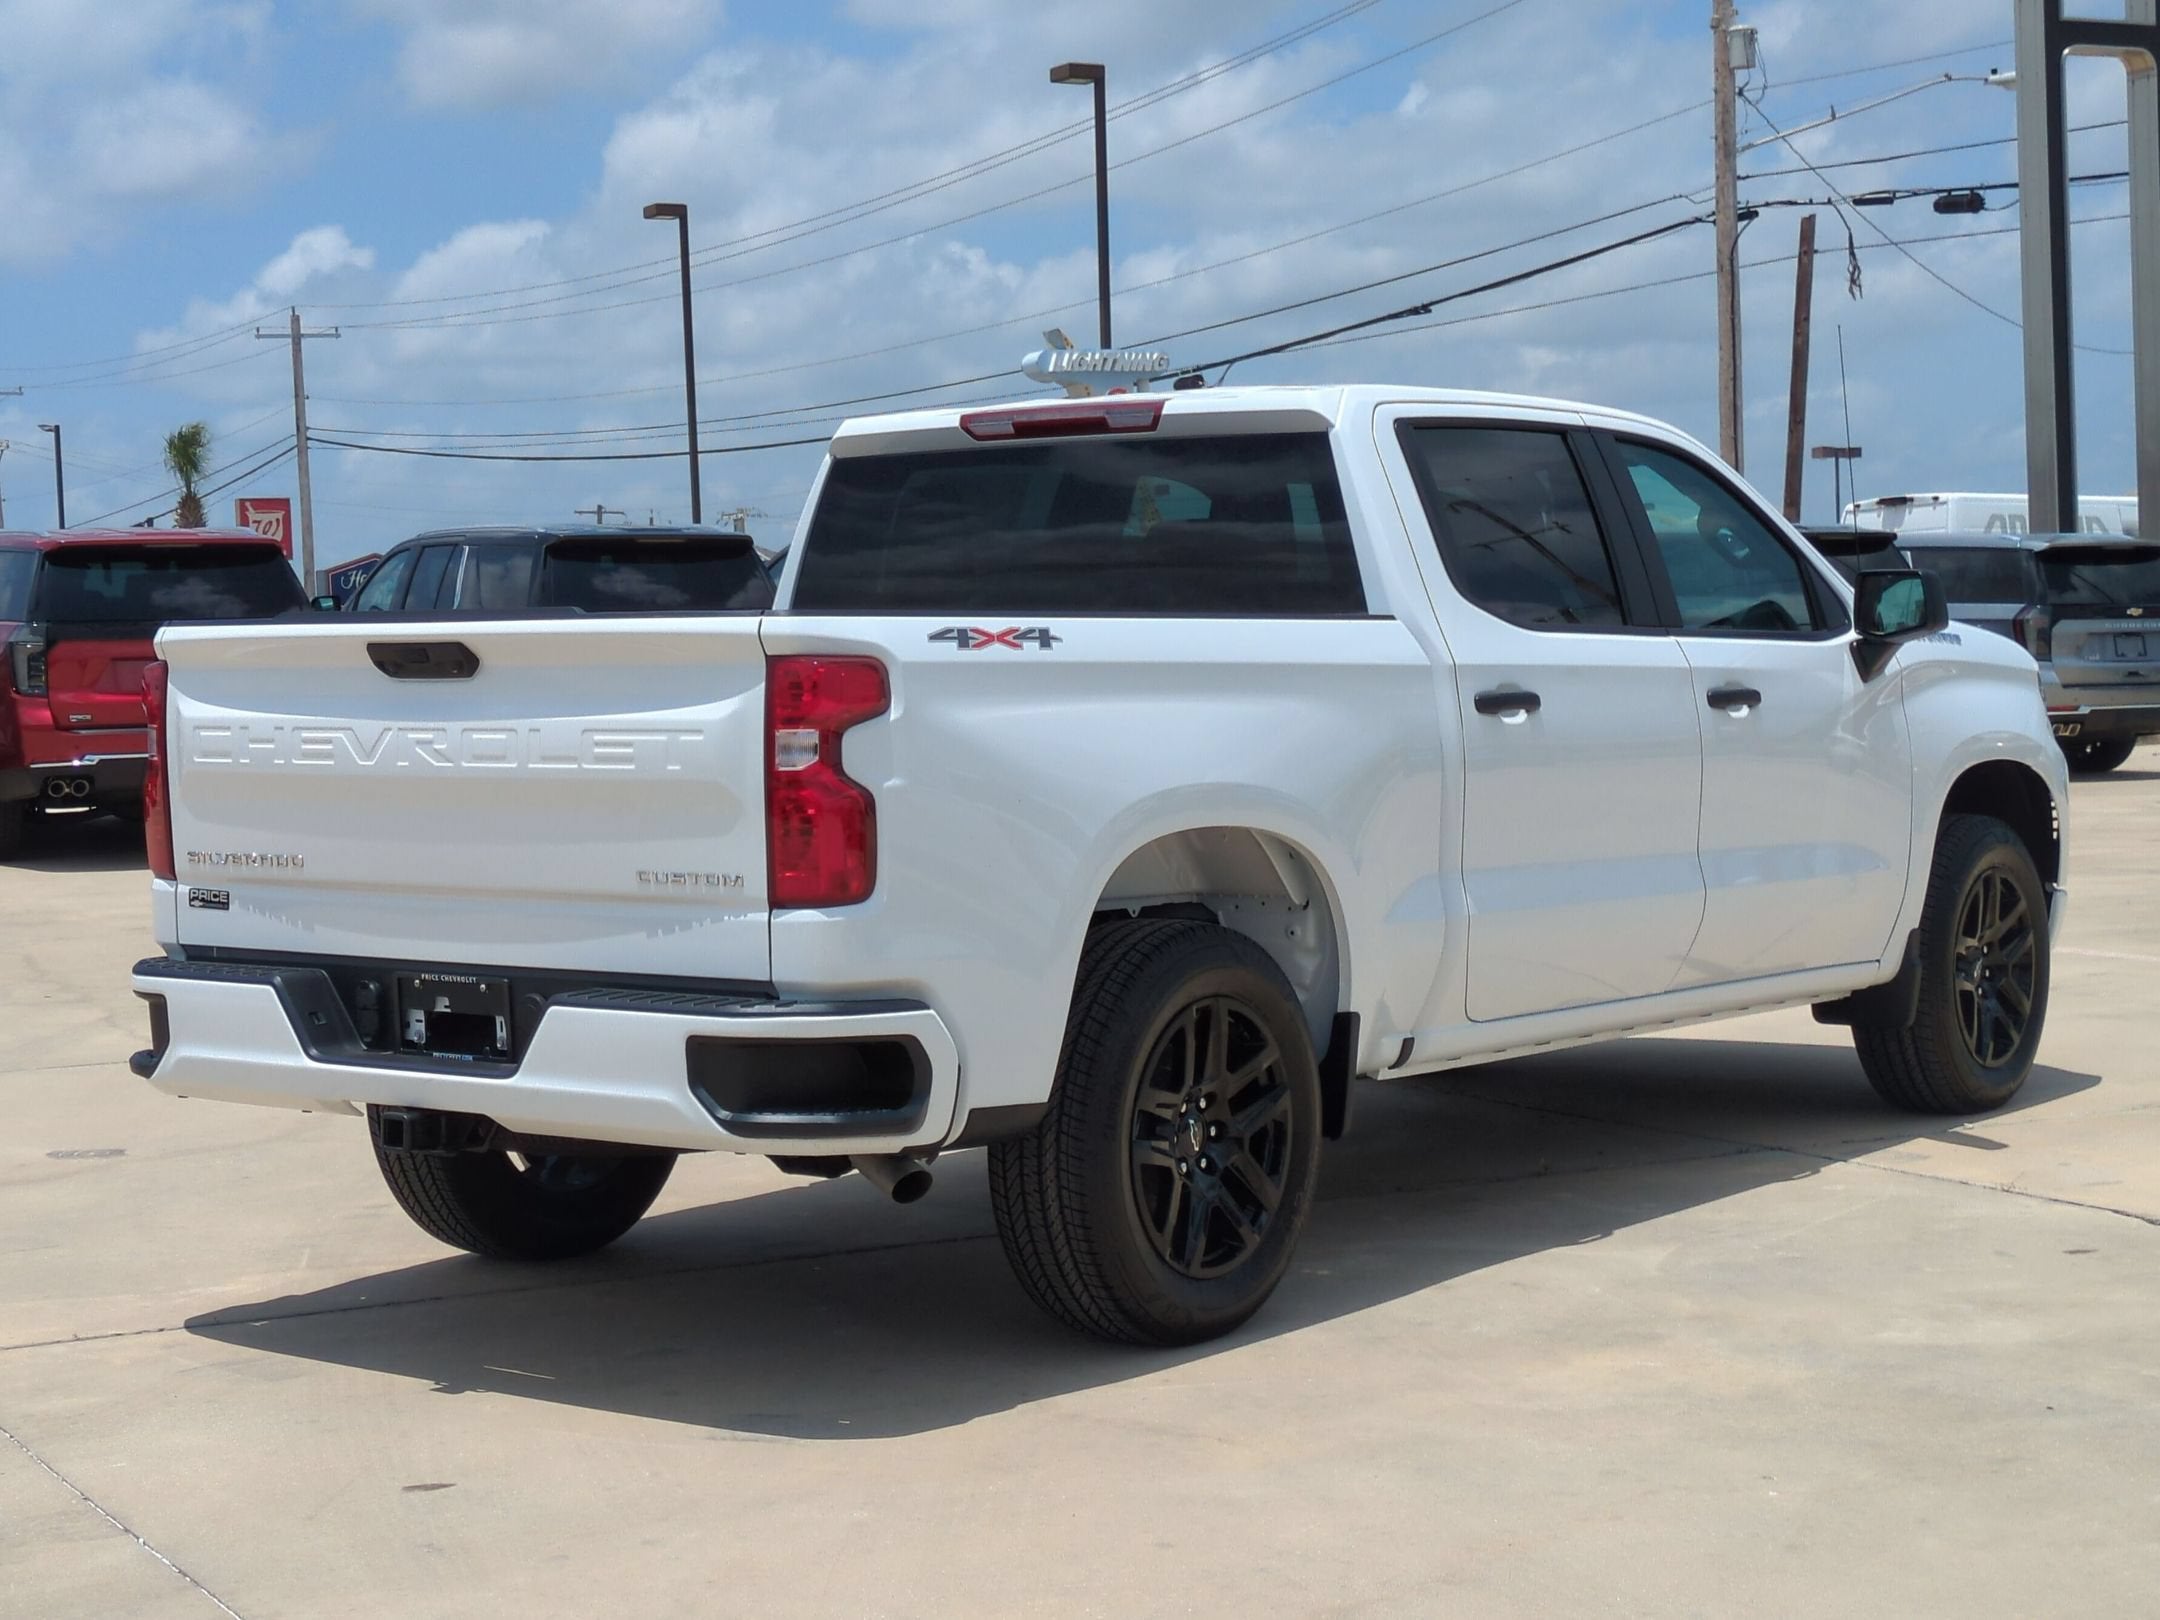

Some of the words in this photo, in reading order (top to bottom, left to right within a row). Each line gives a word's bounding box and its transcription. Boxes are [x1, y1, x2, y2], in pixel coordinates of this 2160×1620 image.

[1048, 351, 1171, 373] LIGHTNING
[192, 725, 705, 770] CHEVROLET
[187, 851, 305, 868] SILVERADO
[636, 870, 745, 888] CUSTOM
[190, 889, 228, 903] PRICE
[421, 973, 439, 981] PRICE
[440, 974, 478, 984] CHEVROLET
